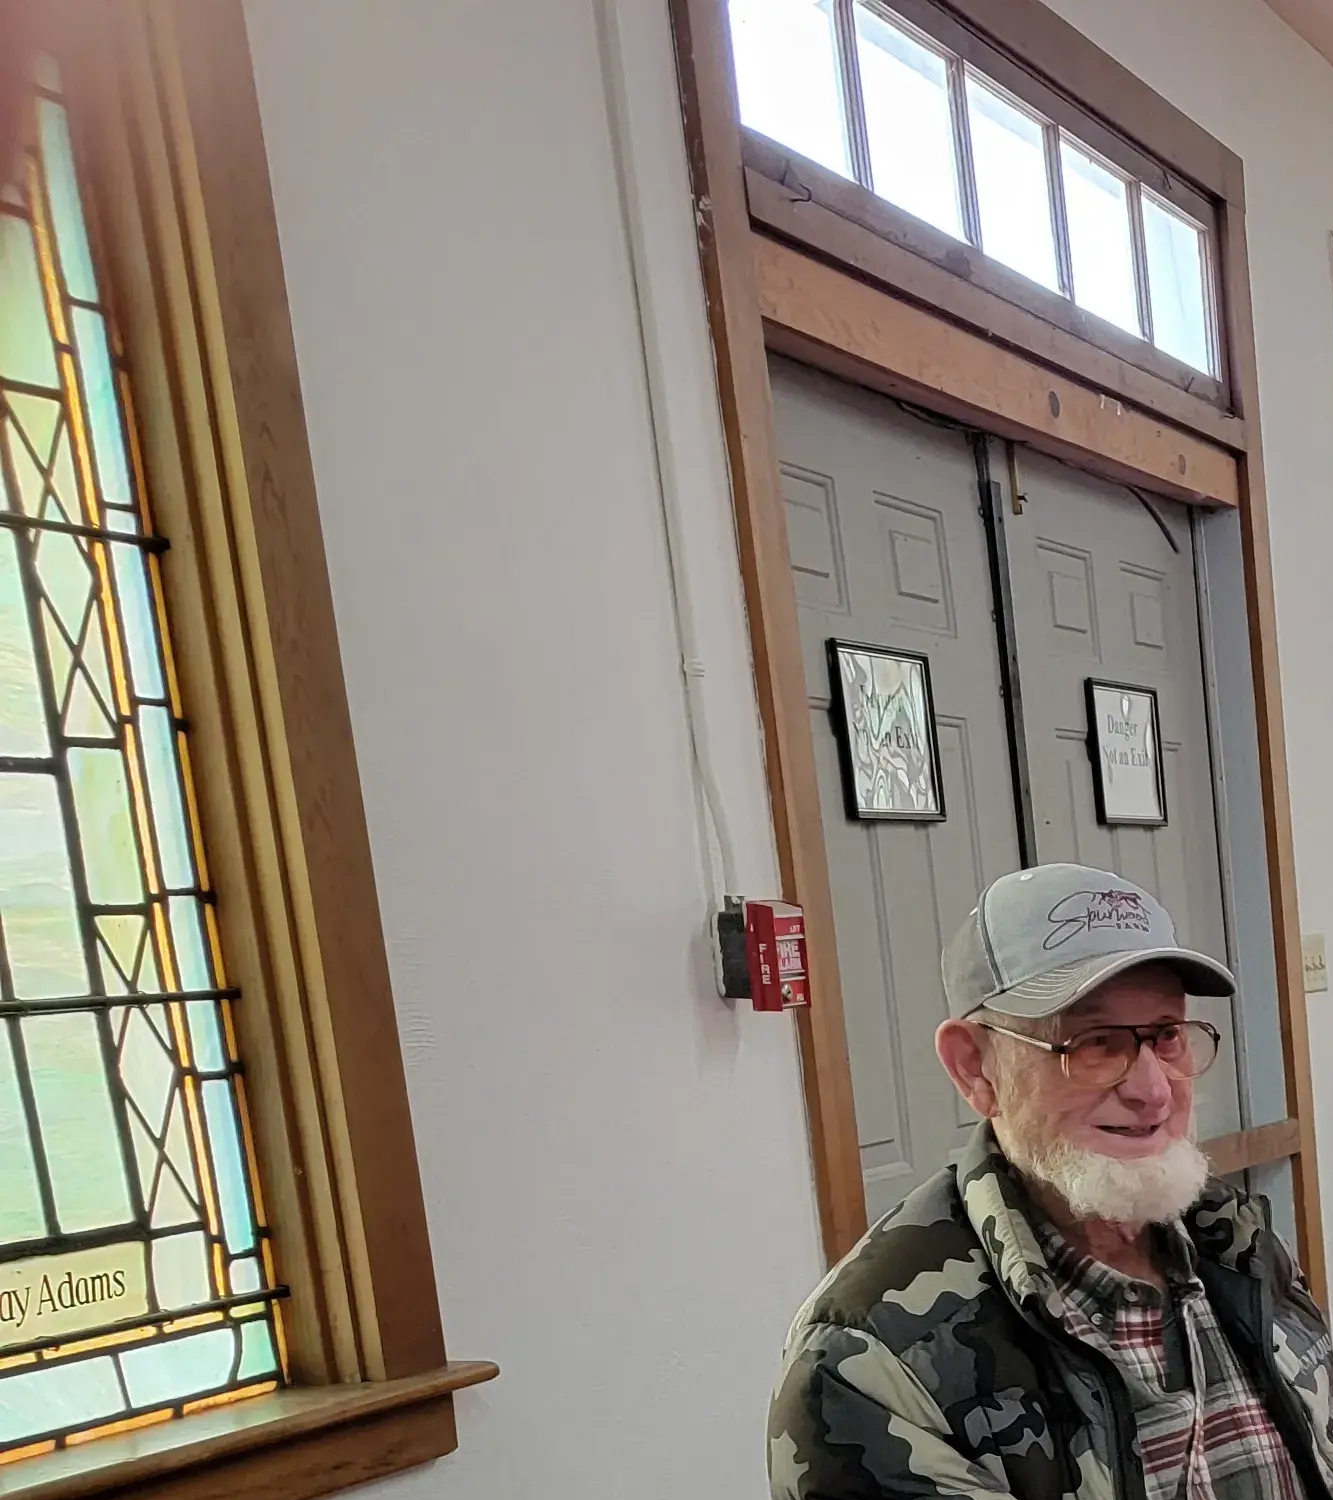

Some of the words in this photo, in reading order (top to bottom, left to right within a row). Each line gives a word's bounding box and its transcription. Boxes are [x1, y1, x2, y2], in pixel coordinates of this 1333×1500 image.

[1107, 713, 1138, 741] Danger
[1131, 747, 1149, 767] Exit
[36, 1270, 126, 1316] Adams
